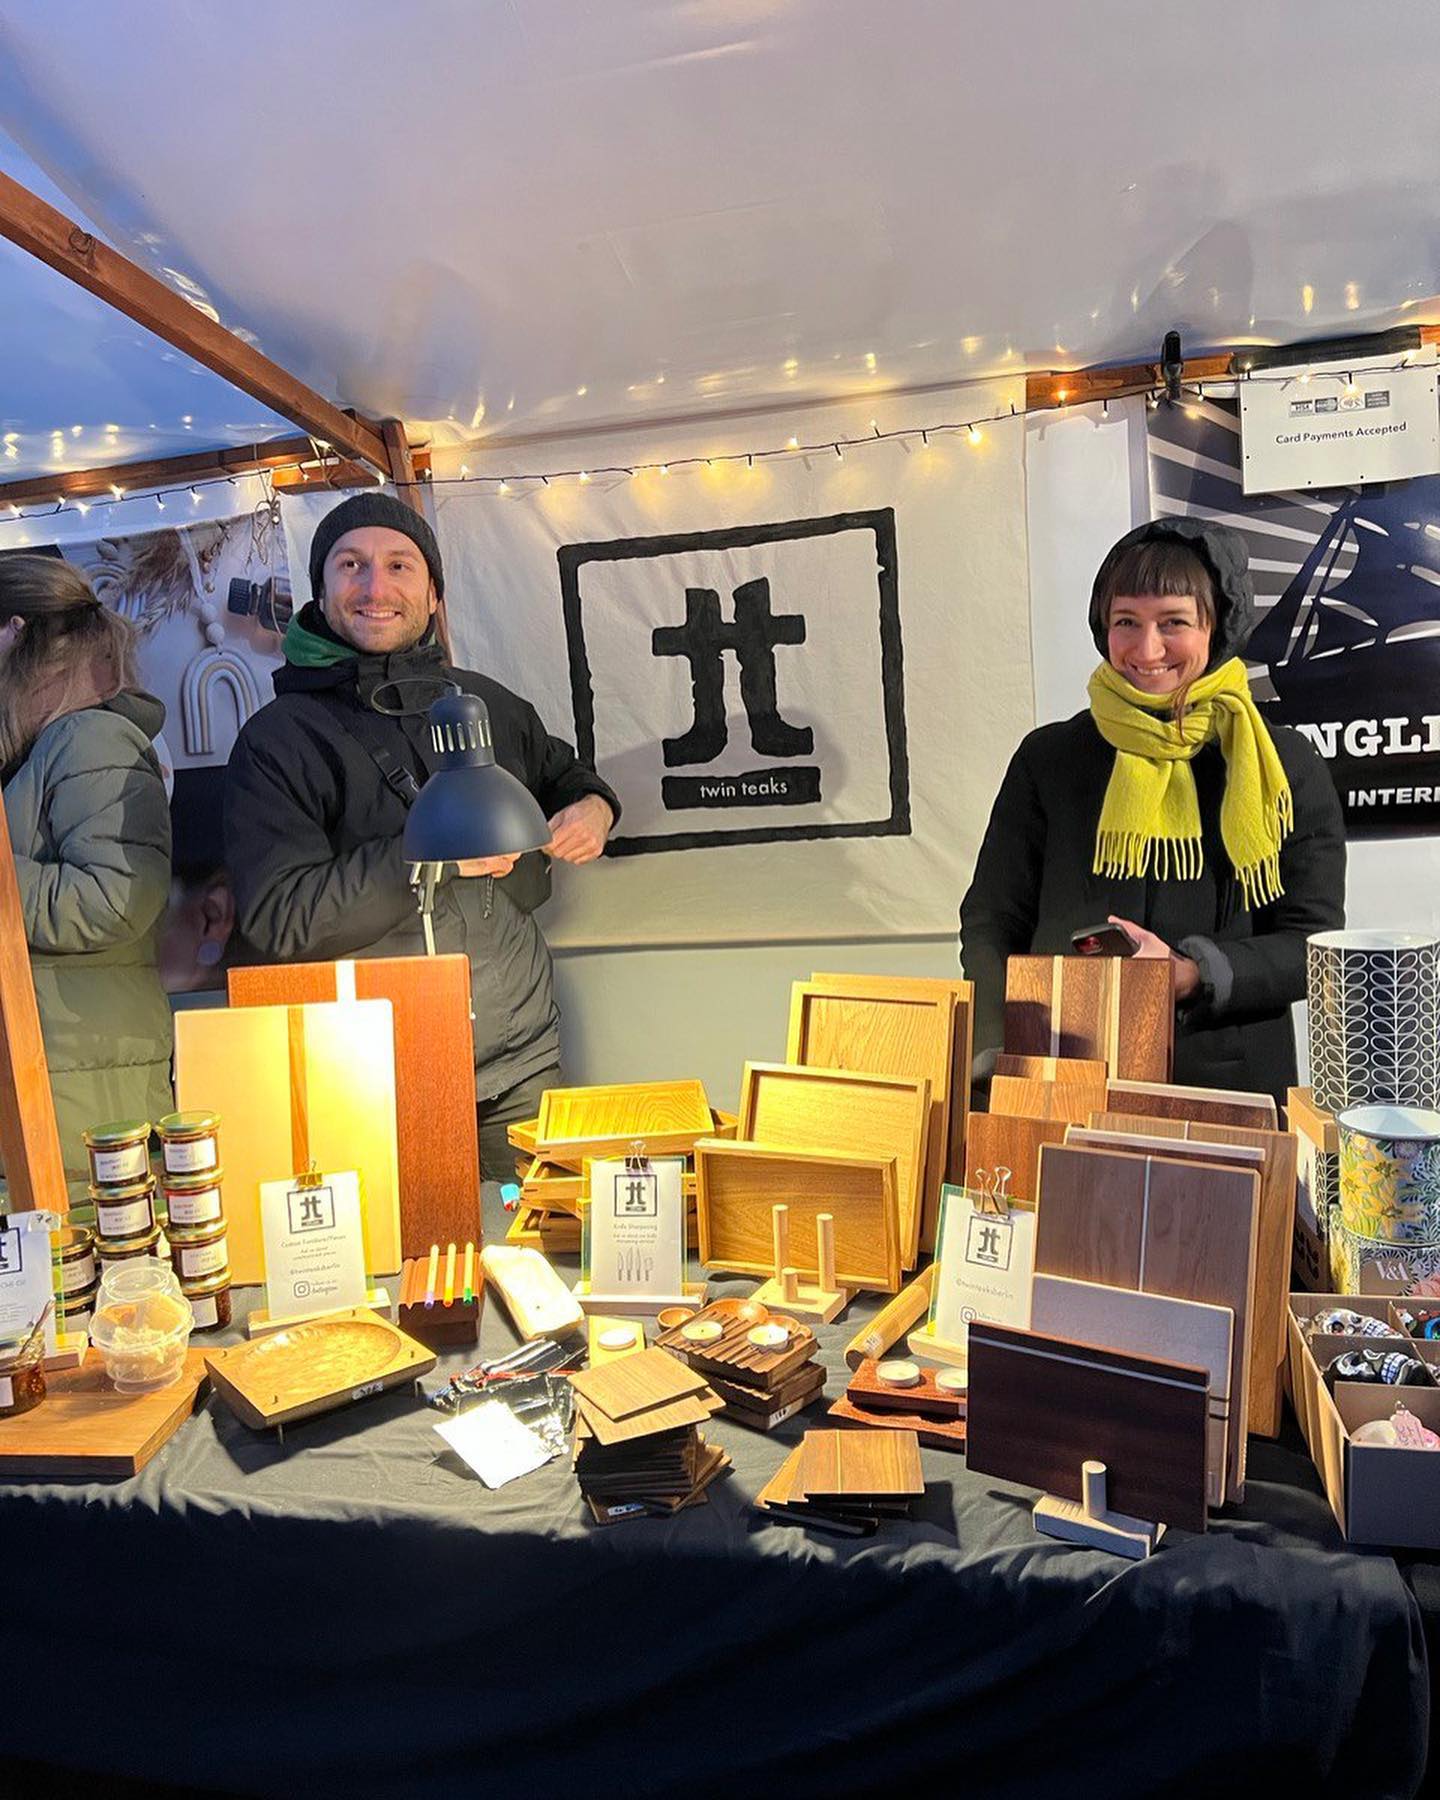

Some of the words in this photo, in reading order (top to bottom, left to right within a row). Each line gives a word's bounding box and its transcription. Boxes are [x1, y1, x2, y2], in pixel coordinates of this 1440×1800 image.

[1276, 433, 1301, 444] Card
[1302, 429, 1354, 443] Payments
[1355, 421, 1407, 437] Accepted
[700, 782, 736, 798] twin
[741, 776, 788, 796] teaks
[1375, 1261, 1409, 1280] V&A
